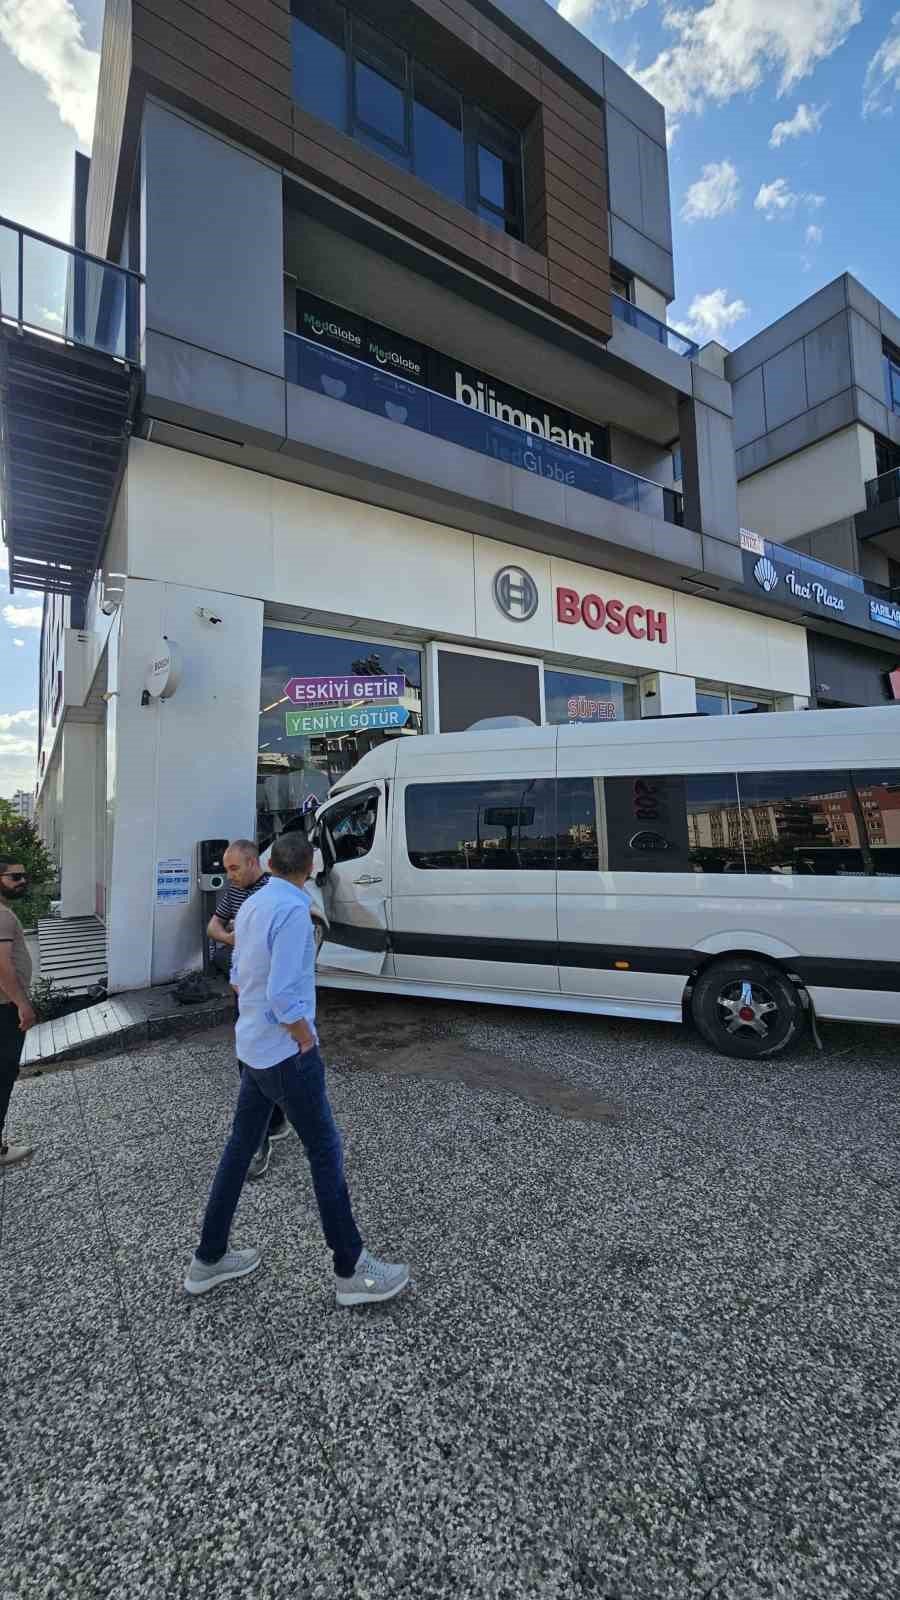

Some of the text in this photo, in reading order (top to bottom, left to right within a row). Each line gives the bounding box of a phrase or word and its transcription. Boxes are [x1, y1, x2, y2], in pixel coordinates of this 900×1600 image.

[303, 312, 361, 345] MedGlobe
[369, 343, 421, 373] MedGlobe
[455, 372, 595, 458] bilimplant
[785, 571, 846, 611] İnci Plaza
[556, 586, 668, 645] BOSCH
[295, 679, 398, 699] ESKİYİ GETİR
[291, 709, 399, 731] YENİYİ GÖTÜR
[568, 696, 616, 720] SÜPER
